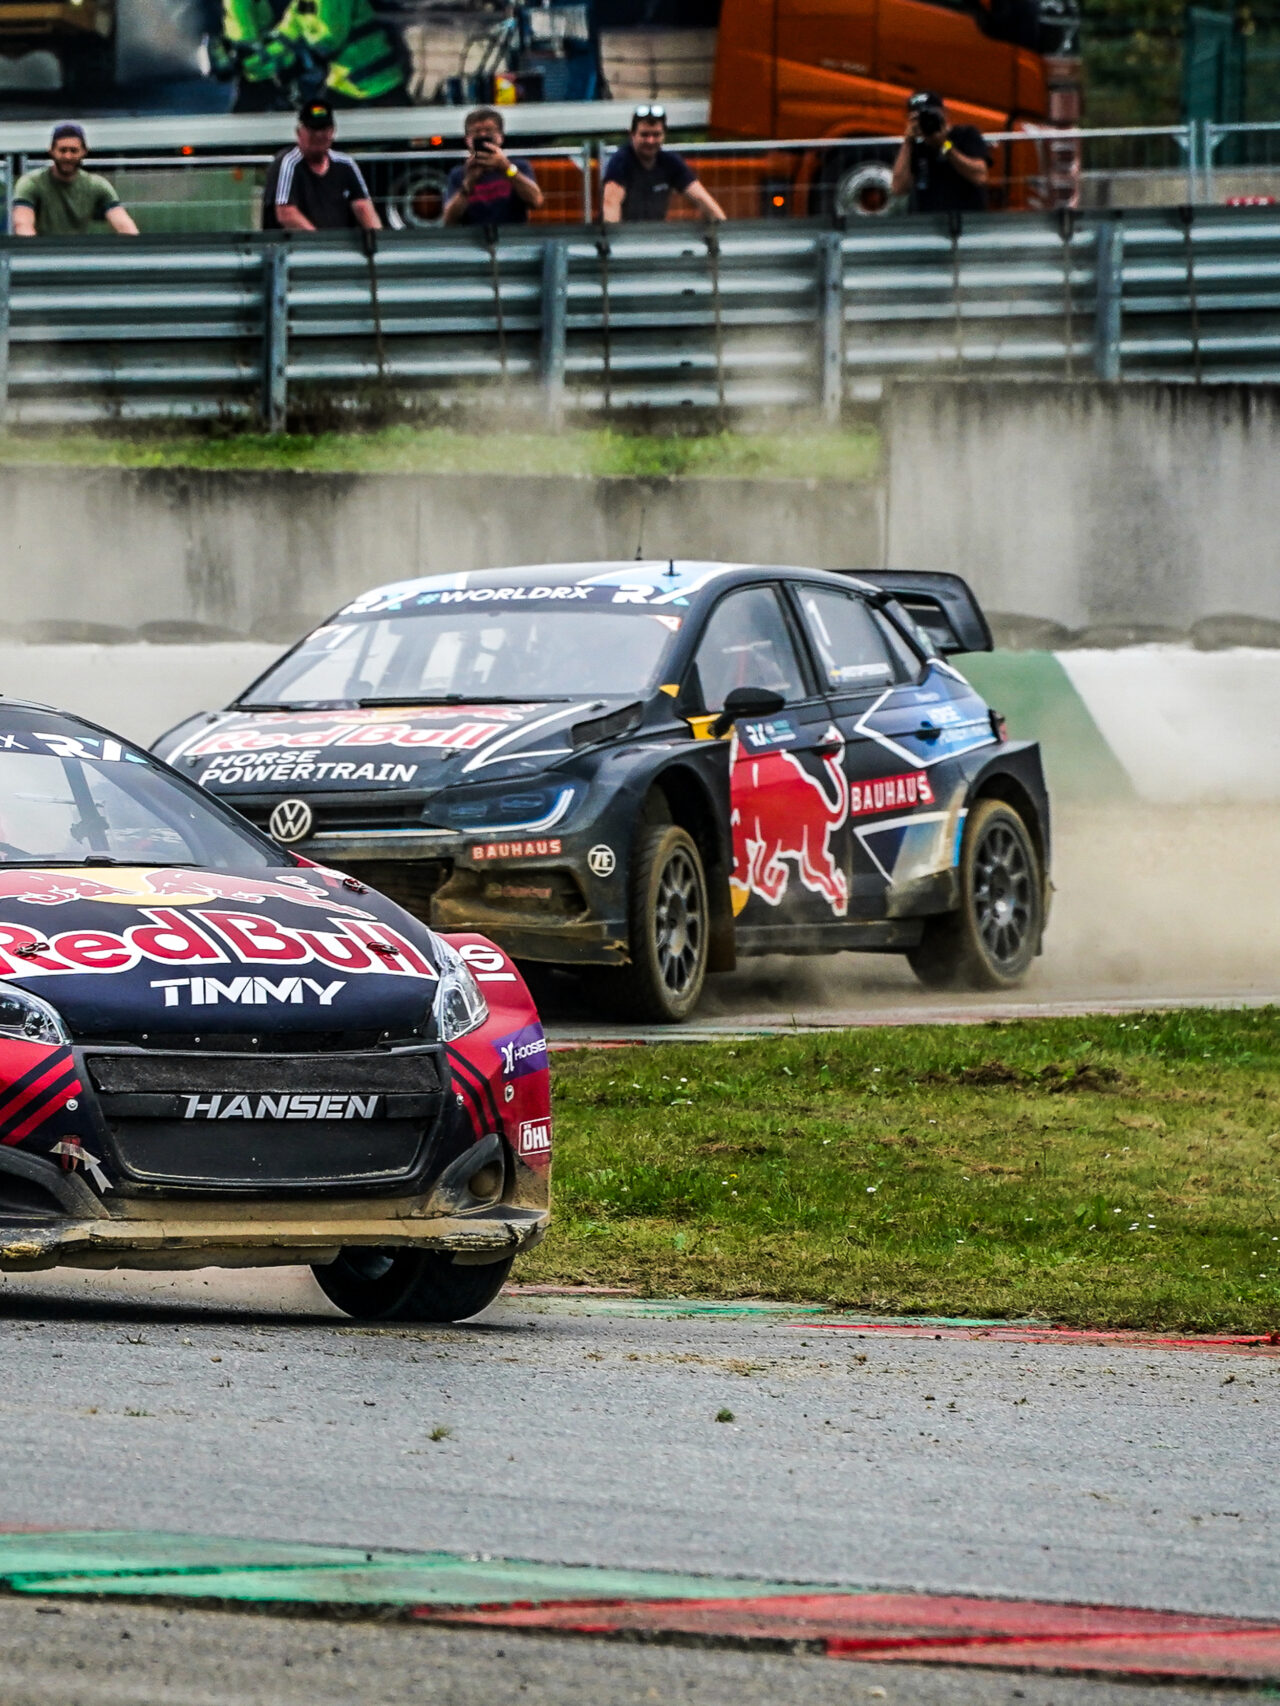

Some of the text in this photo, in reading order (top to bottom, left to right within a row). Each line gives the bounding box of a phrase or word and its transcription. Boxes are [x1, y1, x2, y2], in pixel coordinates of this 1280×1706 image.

[417, 586, 595, 606] #WORLDRX
[612, 584, 690, 606] RX
[32, 731, 148, 764] RX
[191, 723, 504, 754] Red Bull
[209, 750, 322, 769] HORSE
[199, 762, 418, 786] POWERTRAIN
[852, 775, 932, 811] BAUHAUS
[473, 840, 562, 860] BAUHAUS
[202, 909, 437, 978] Bull
[151, 976, 347, 1007] TIMMY
[180, 1094, 380, 1120] HANSEN
